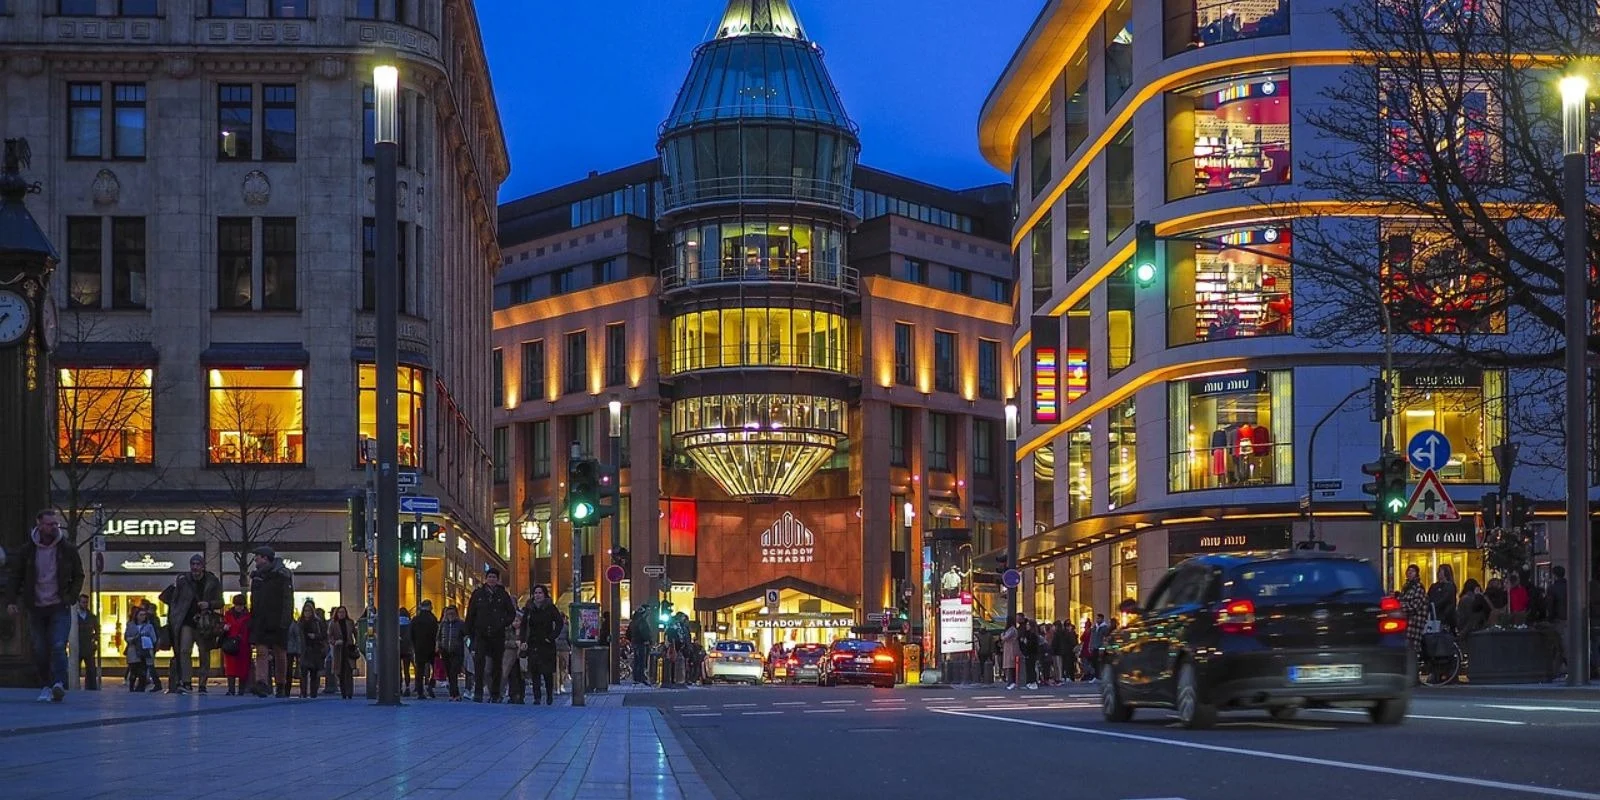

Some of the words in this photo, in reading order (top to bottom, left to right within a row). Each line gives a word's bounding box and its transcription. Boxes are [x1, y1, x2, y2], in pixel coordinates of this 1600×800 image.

[103, 519, 196, 535] WEMPE
[762, 548, 814, 556] SCHADOW
[762, 555, 814, 563] ARKADEN
[748, 619, 802, 628] SCHADOW
